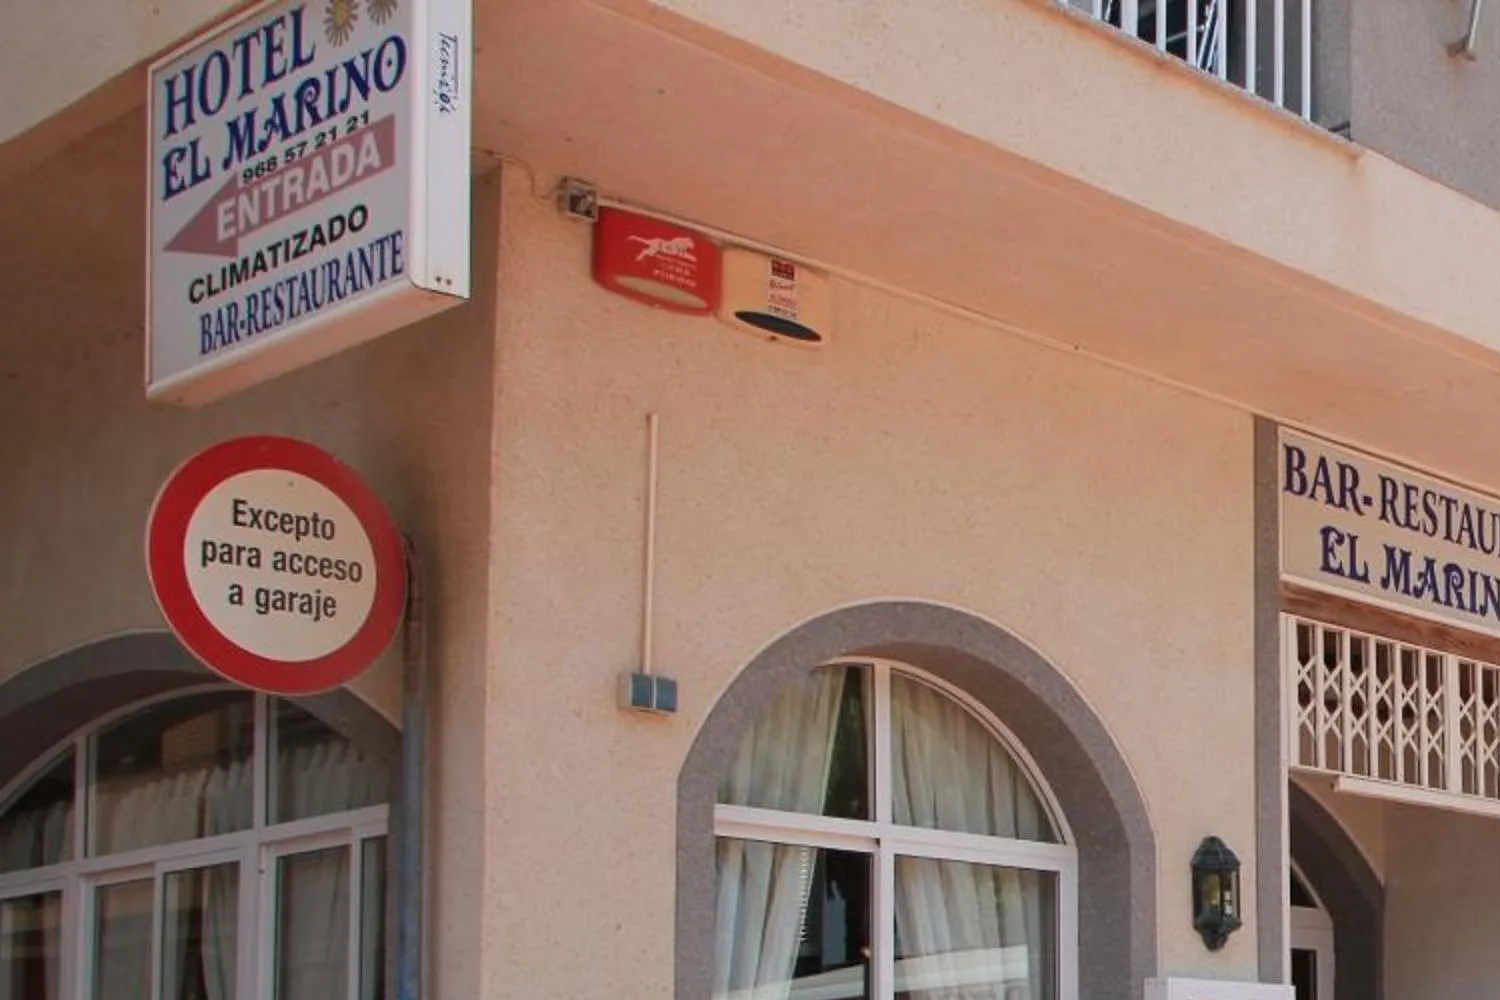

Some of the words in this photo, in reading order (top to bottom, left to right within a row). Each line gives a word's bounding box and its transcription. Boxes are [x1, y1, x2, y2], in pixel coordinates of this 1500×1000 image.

[162, 6, 316, 140] HOTEL
[162, 136, 212, 201] EL
[222, 35, 407, 171] MARINO
[314, 125, 338, 149] 21
[346, 110, 370, 134] 21
[216, 133, 382, 242] ENTRADA
[188, 203, 369, 305] CLIMATIZADO
[232, 498, 335, 542] Excepto
[201, 539, 262, 568] para
[272, 549, 363, 583] acceso
[1319, 525, 1370, 585] EL
[228, 583, 244, 606] a
[255, 583, 337, 622] garaje
